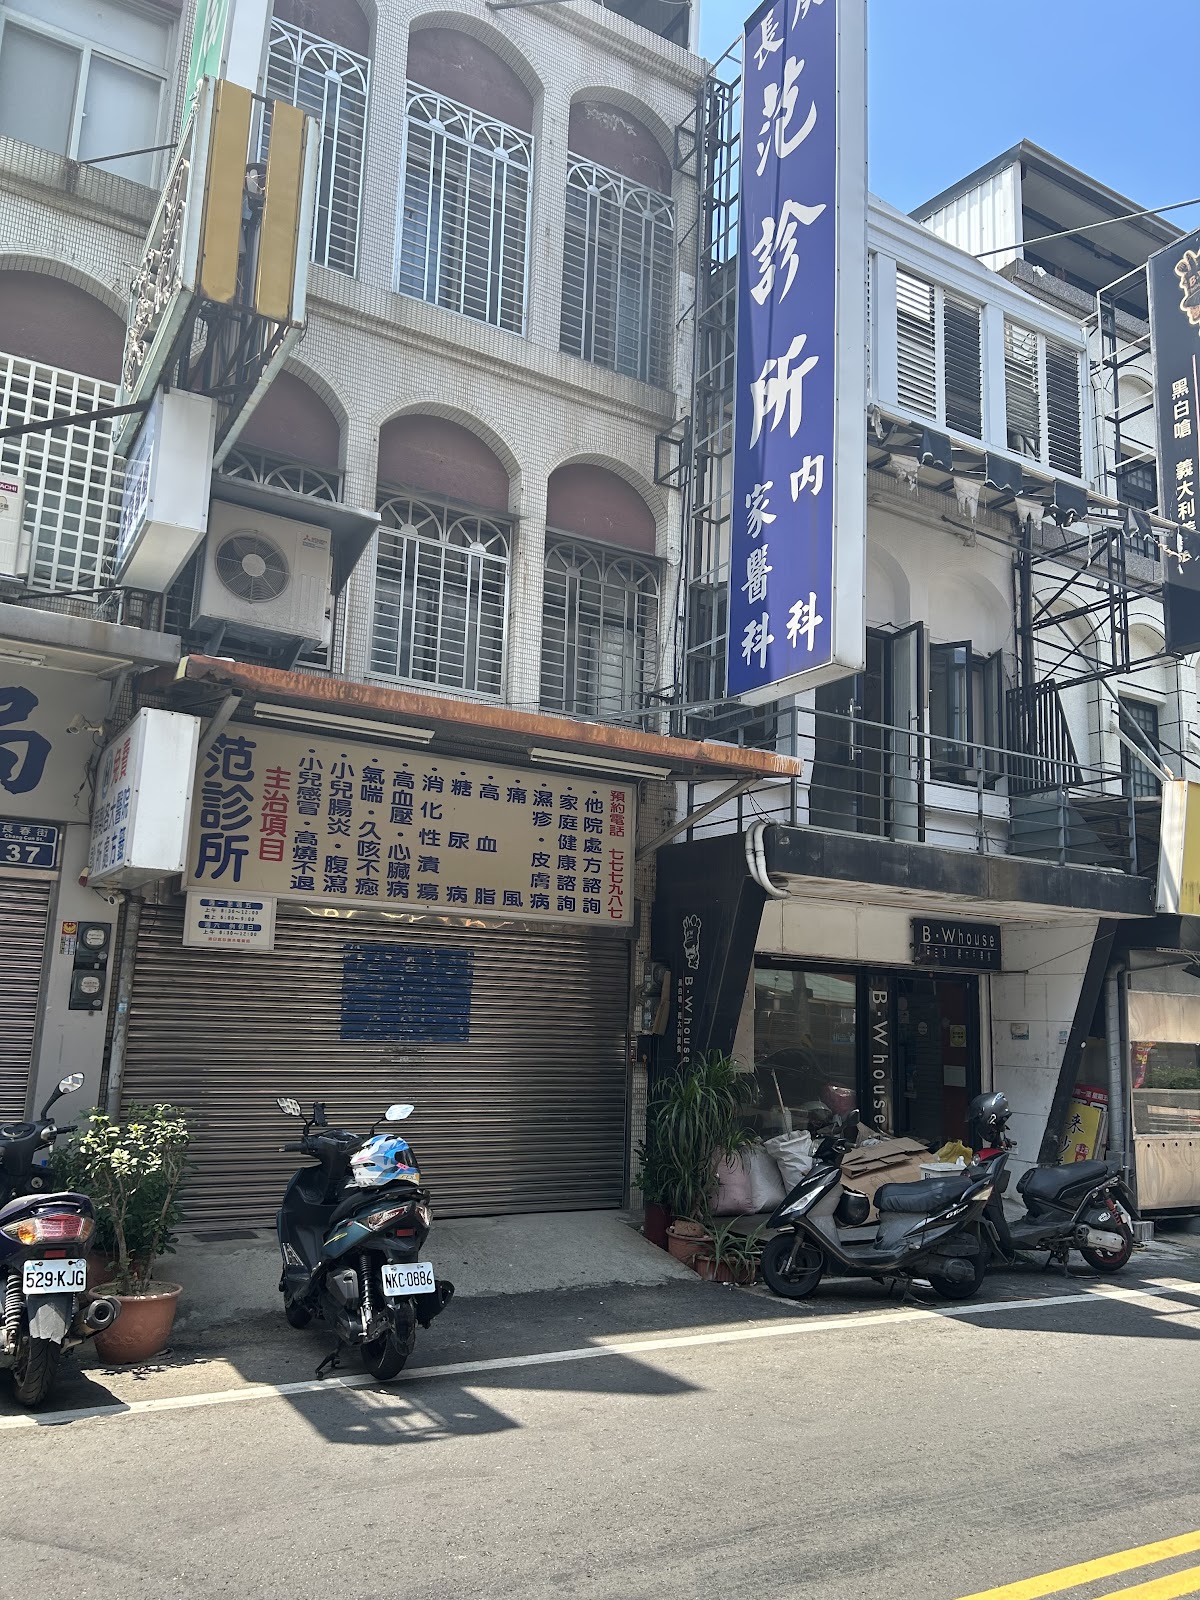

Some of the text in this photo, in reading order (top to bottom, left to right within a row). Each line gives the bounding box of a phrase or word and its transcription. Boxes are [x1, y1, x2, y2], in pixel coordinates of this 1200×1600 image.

[750, 55, 826, 449] 范診所
[741, 480, 777, 669] 家醫科
[2, 824, 48, 838] 長春街
[6, 844, 40, 864] 37
[194, 733, 257, 882] 范診所
[259, 766, 291, 861] 主治項目
[417, 774, 444, 901] 消化性潰瘍
[446, 779, 472, 904] 糖尿病
[475, 783, 500, 905] 高血脂
[503, 787, 528, 908] 痛風
[557, 794, 578, 912] 家庭健康諮詢
[582, 797, 604, 915] 他院處方諮詢
[608, 790, 626, 919] 預約電話 七七七九八七
[26, 1270, 84, 1288] 529-KJG
[384, 1269, 433, 1289] NKC-0886
